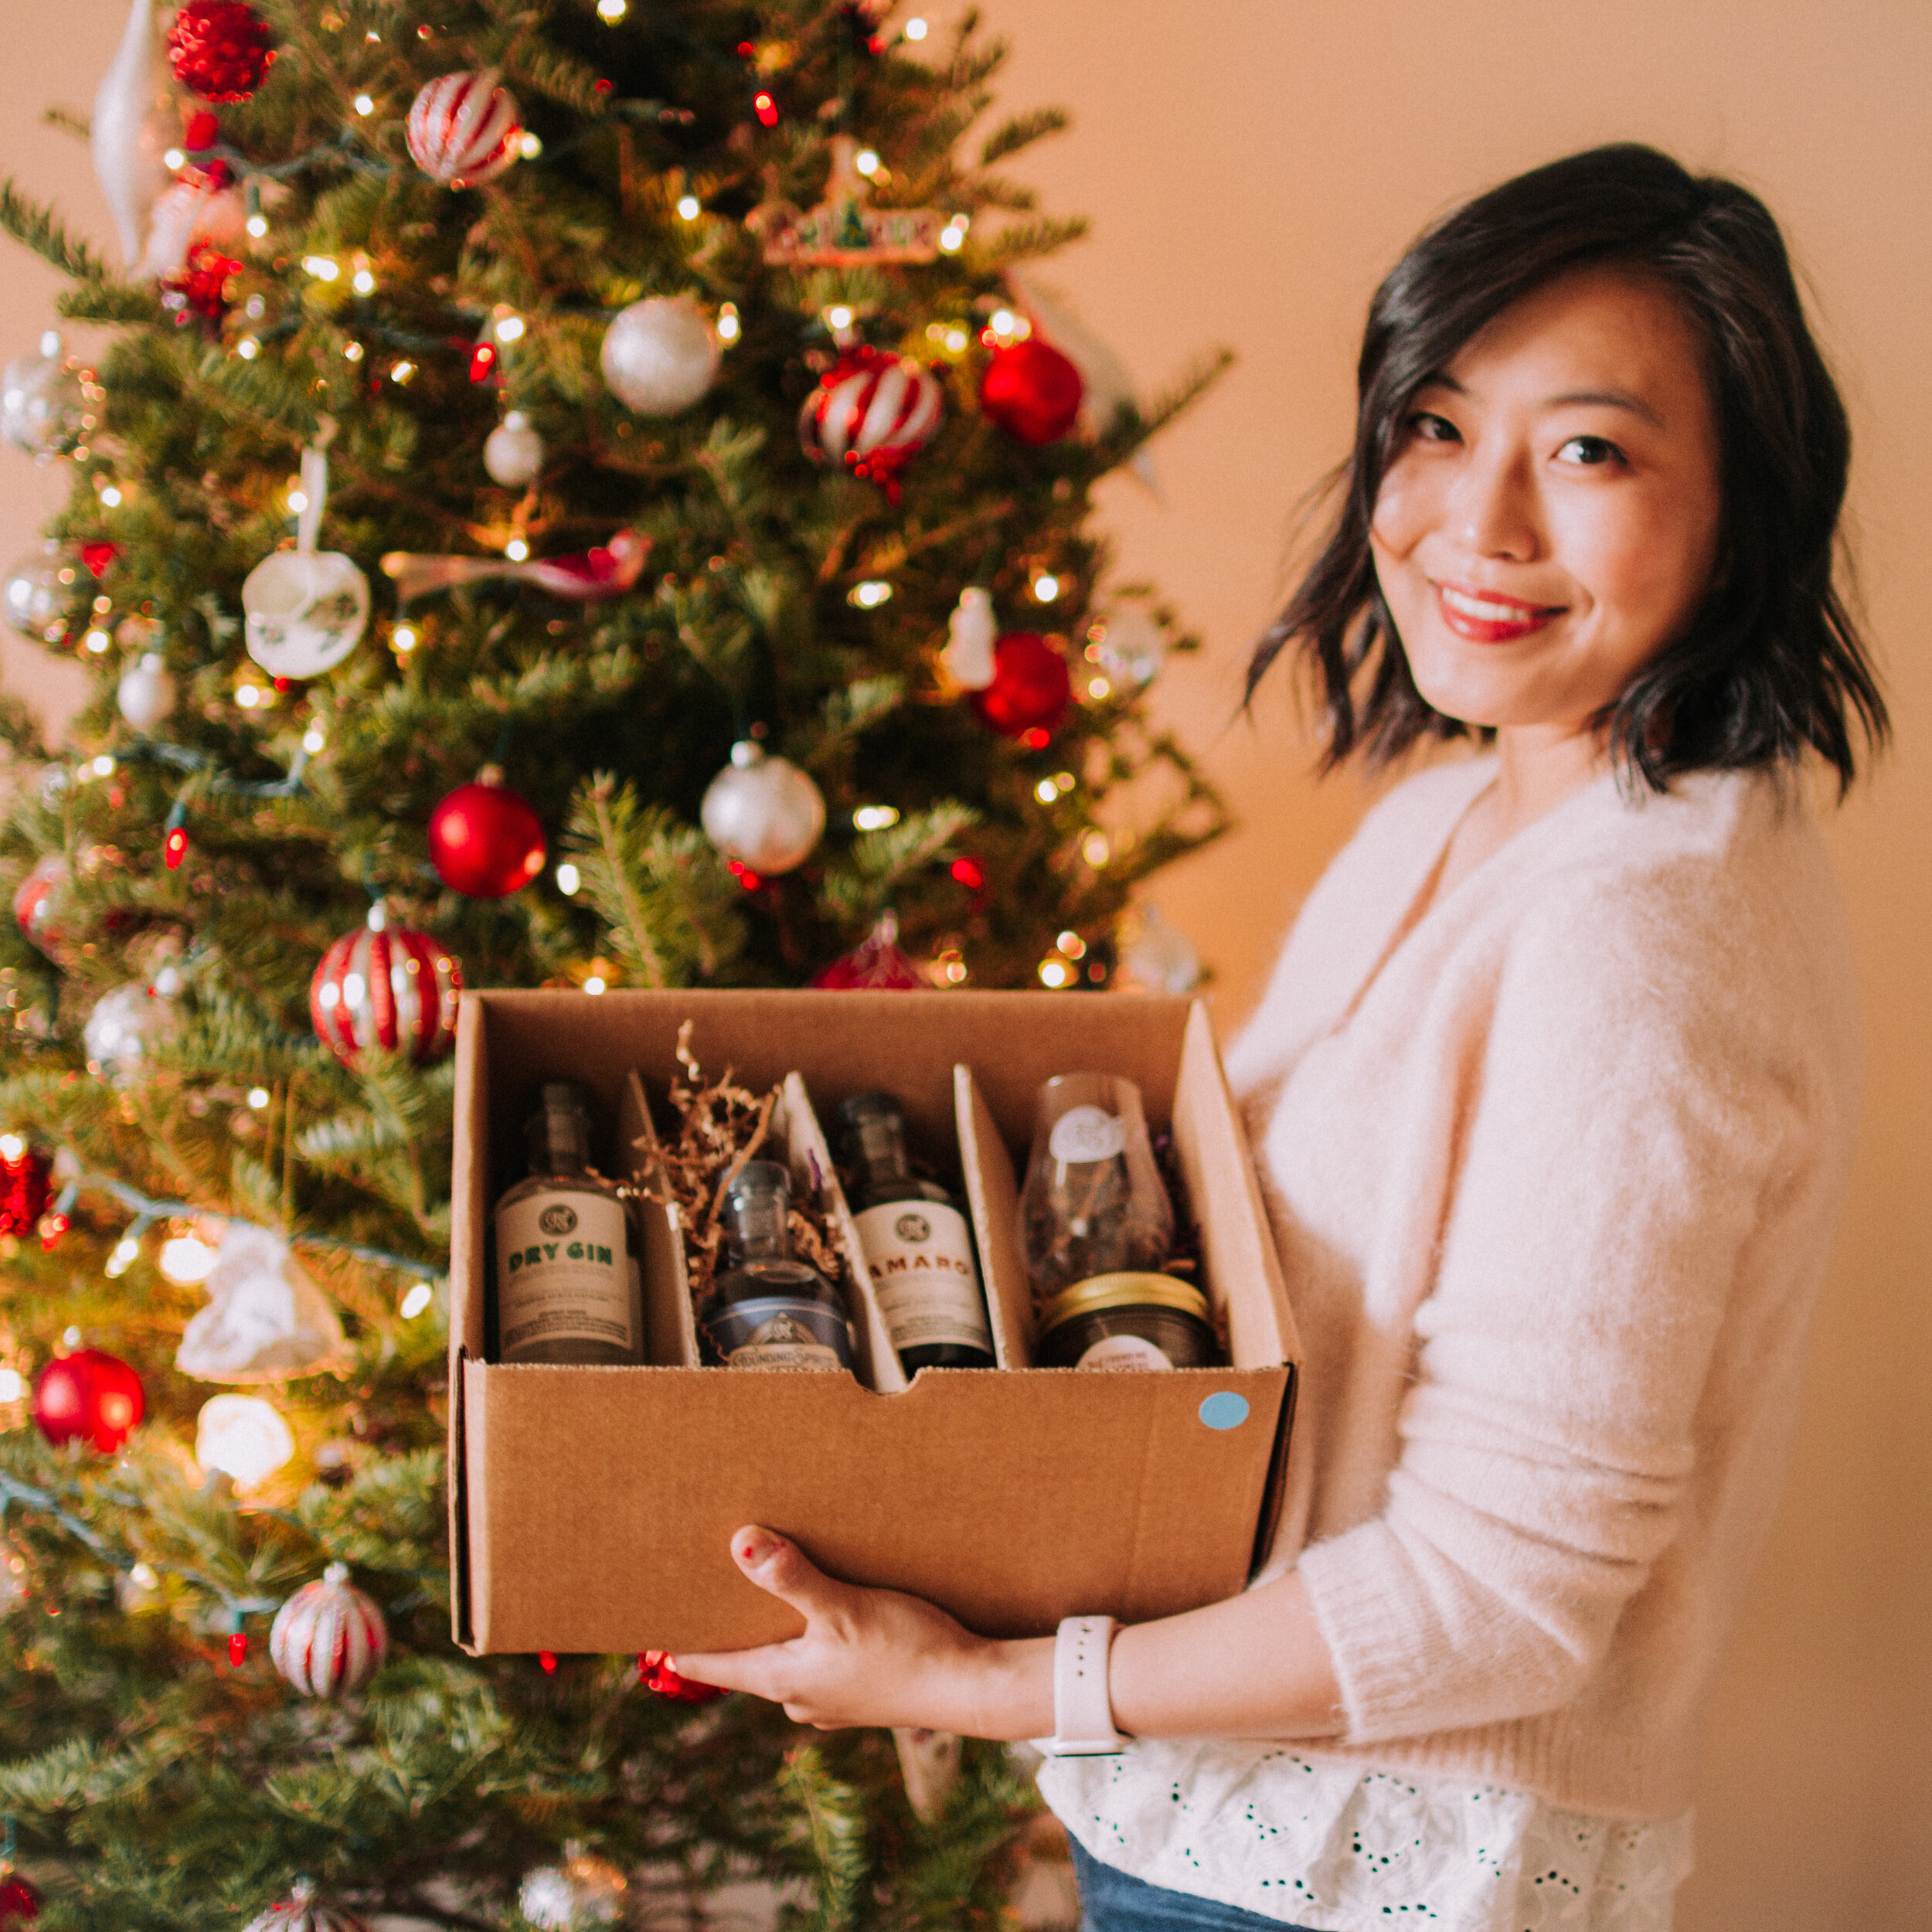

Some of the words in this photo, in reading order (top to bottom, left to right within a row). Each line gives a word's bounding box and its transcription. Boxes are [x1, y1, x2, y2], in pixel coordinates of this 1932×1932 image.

[509, 1243, 559, 1273] DRY
[566, 1242, 612, 1265] GIN
[869, 1254, 968, 1277] AMARO
